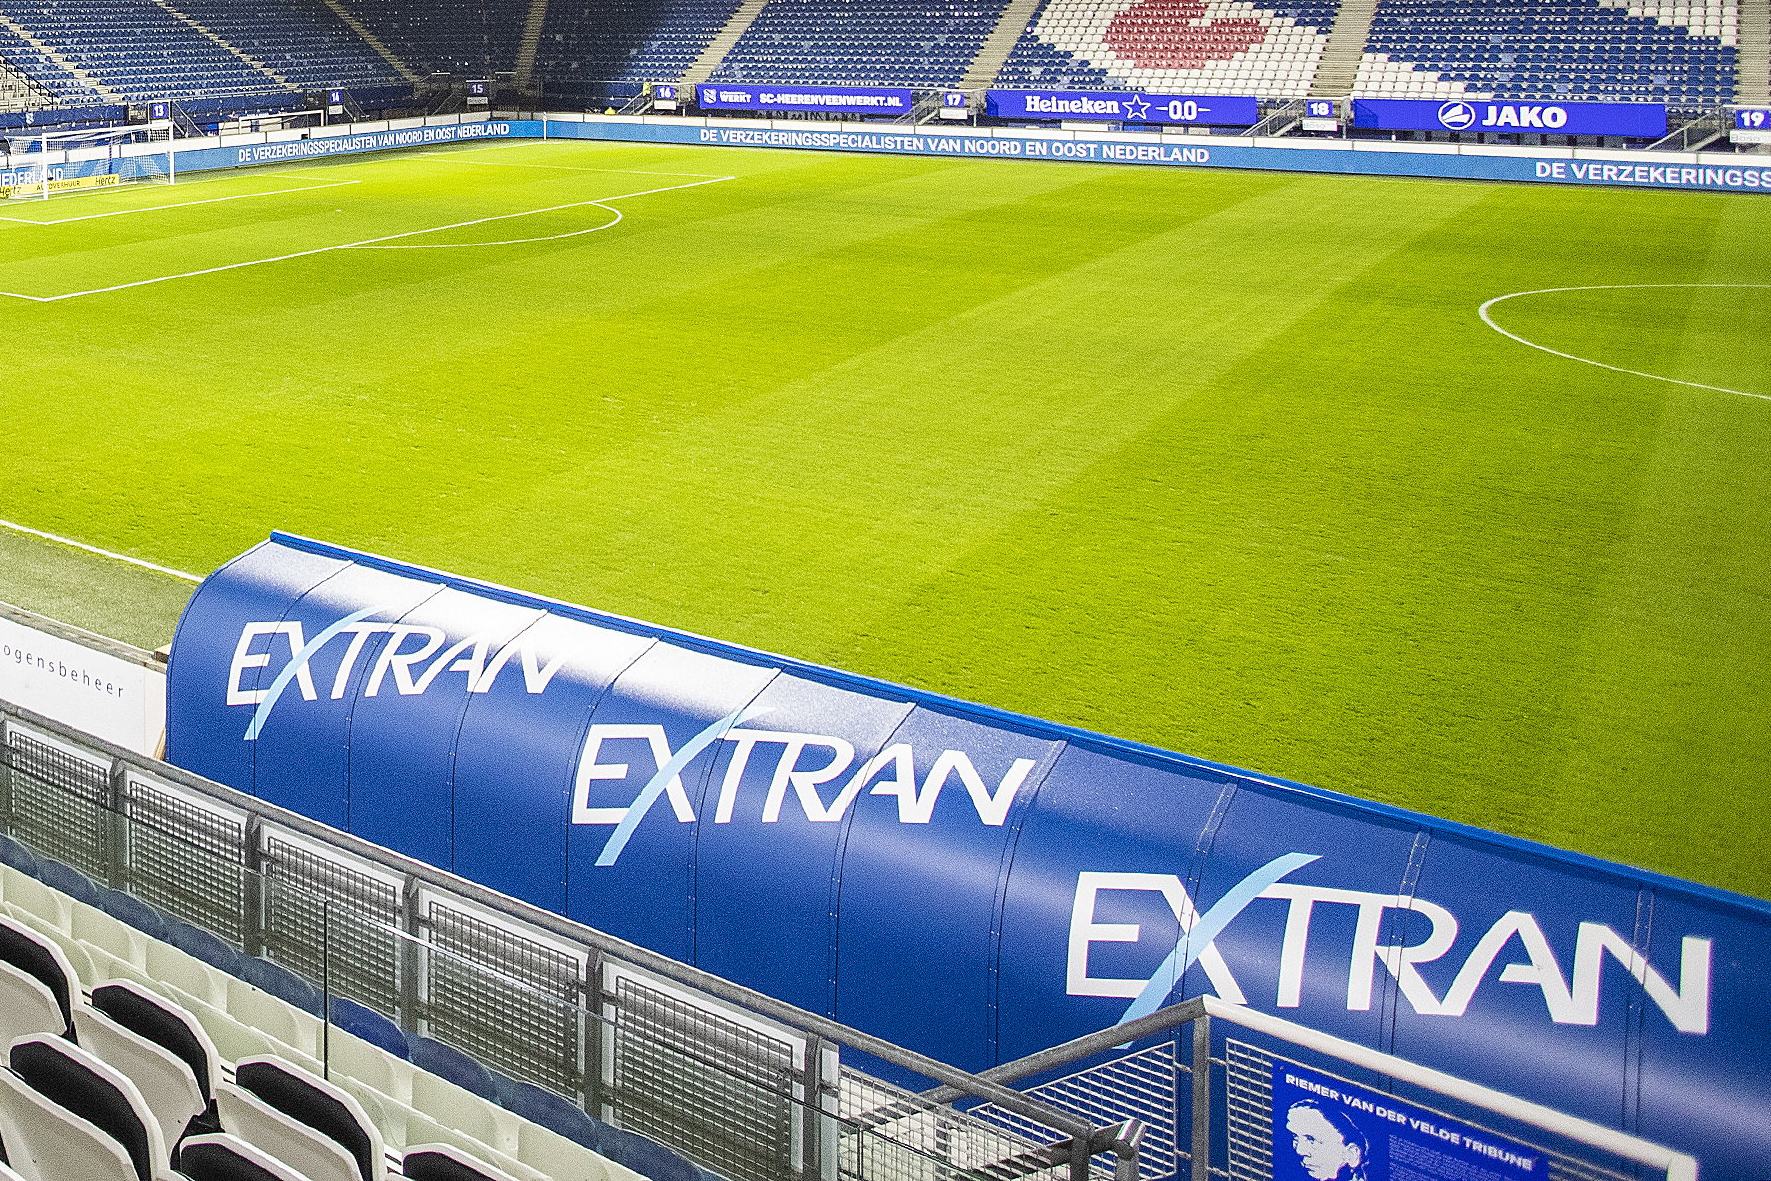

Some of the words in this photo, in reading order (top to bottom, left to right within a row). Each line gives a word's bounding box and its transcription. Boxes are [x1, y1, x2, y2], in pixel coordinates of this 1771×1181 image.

[331, 92, 340, 102] 14
[471, 84, 484, 94] 15
[660, 87, 672, 99] 16
[719, 93, 752, 104] WERKT
[759, 93, 903, 108] SC-HEERENVEENWERKT.NL
[947, 94, 961, 106] 17
[1025, 95, 1120, 114] Heineken
[154, 104, 164, 117] 13
[1310, 103, 1329, 116] 18
[1482, 106, 1568, 129] JAKO
[1741, 110, 1765, 128] 19
[239, 149, 252, 162] DE
[253, 137, 377, 160] VERZEKERINGSSPECIALISTEN
[378, 133, 394, 147] VAN
[396, 131, 423, 144] NOORD
[424, 129, 434, 141] EN
[435, 126, 456, 140] OOST
[457, 123, 510, 138] NEDERLAND
[700, 129, 718, 142] DE
[720, 129, 924, 151] VERZEKERINGSSPECIALISTEN
[927, 138, 961, 153] VAN
[964, 139, 1021, 155] NOORD
[1026, 142, 1047, 157] EN
[1051, 143, 1099, 159] OOST
[1103, 144, 1210, 164] NEDERLAND
[1535, 161, 1566, 179] DE
[95, 176, 116, 186] Hertz
[227, 606, 564, 740] EXTRAN
[571, 705, 1034, 868] EXTRAN
[1067, 853, 1710, 1048] EXTRAN
[1285, 1073, 1340, 1102] RIEMER
[1342, 1094, 1375, 1115] VAN
[1375, 1106, 1408, 1126] DER
[1409, 1118, 1461, 1145] VELDE
[1462, 1136, 1537, 1172] TRIBUNE
